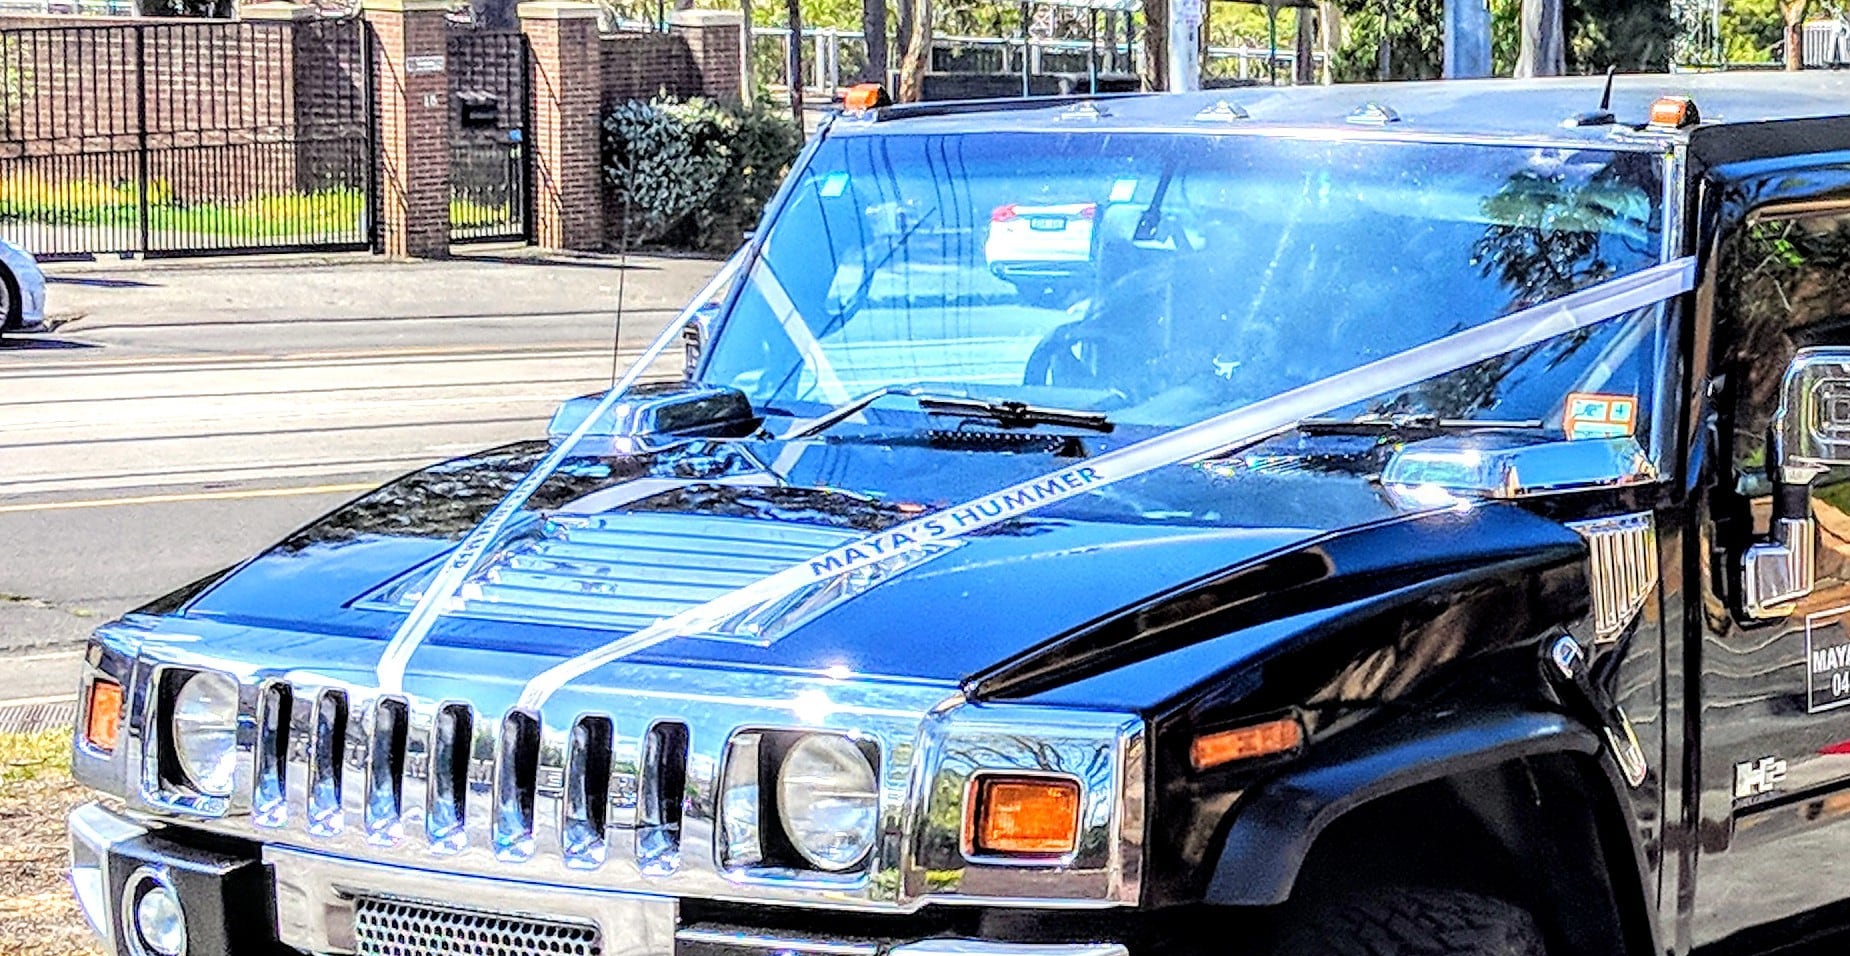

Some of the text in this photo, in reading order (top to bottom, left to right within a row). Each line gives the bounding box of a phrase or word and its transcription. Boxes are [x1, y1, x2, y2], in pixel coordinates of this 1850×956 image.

[807, 466, 1105, 577] MAYA'S HUMMER
[1735, 757, 1787, 797] H2
